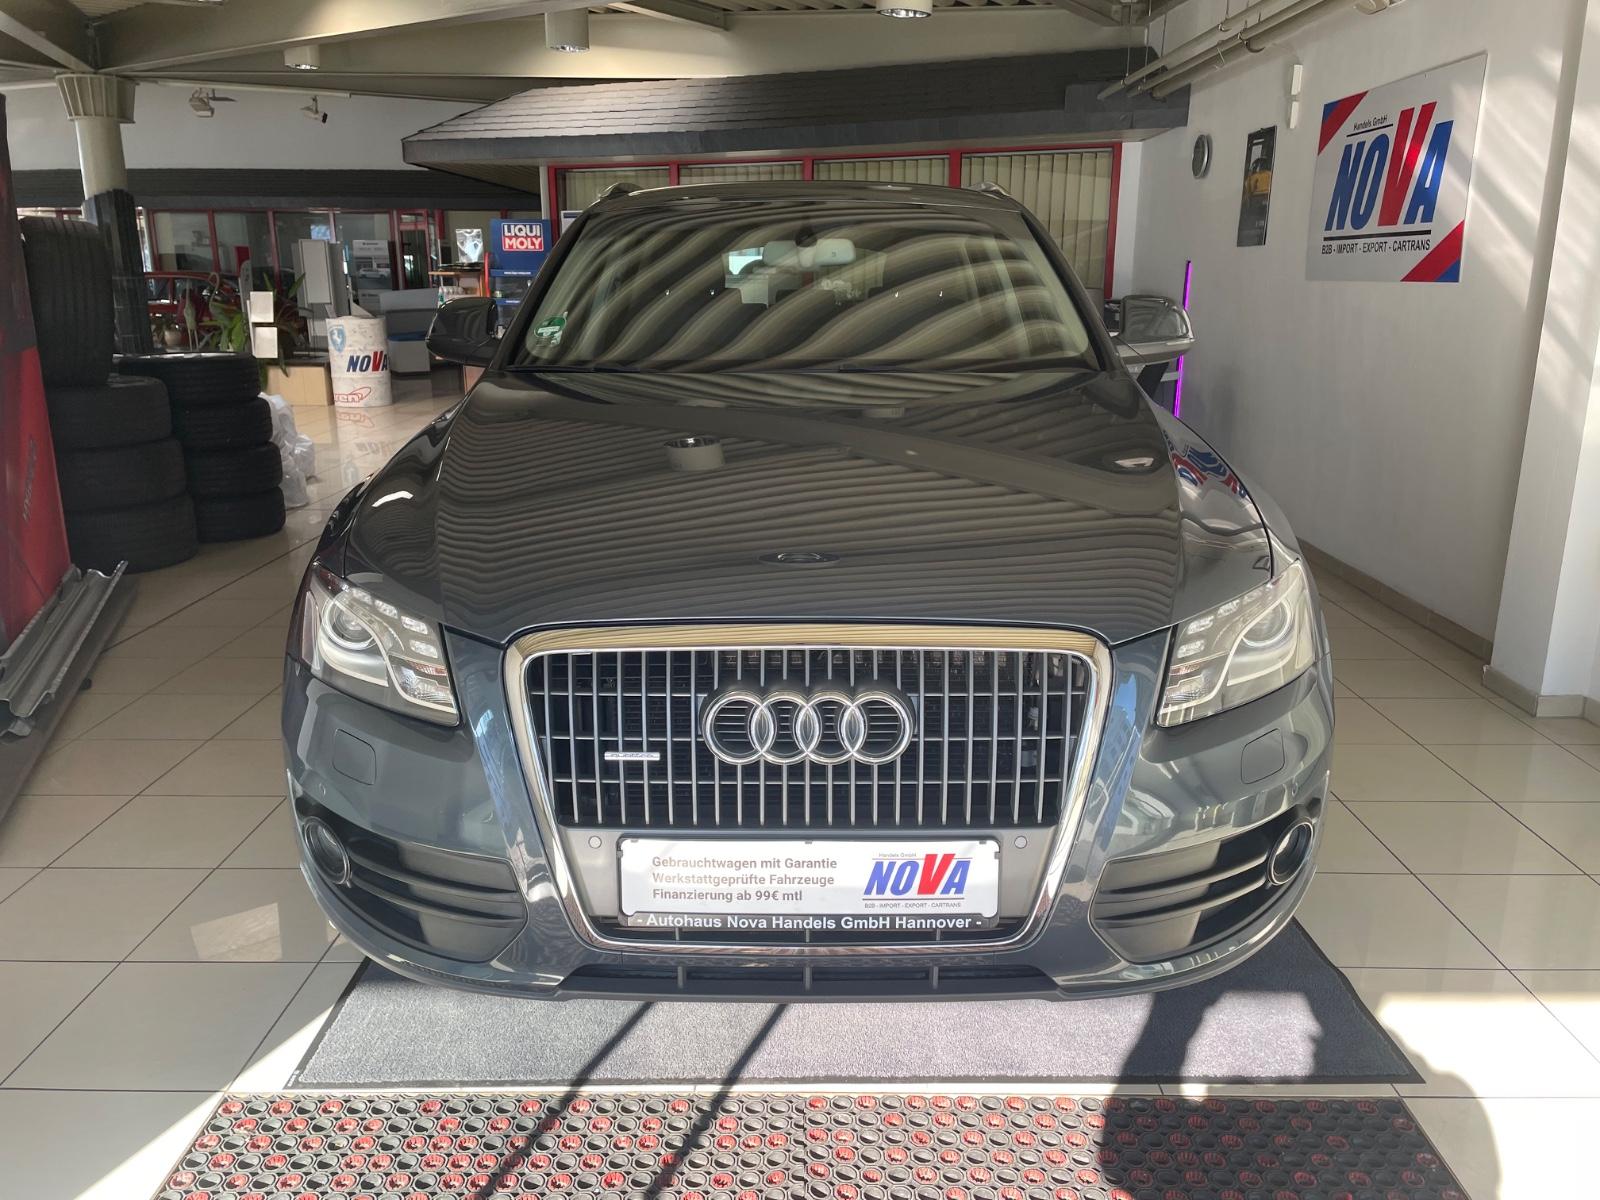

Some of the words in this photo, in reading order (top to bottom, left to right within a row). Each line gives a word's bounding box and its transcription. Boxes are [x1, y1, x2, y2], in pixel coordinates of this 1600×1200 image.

[1353, 120, 1372, 131] Handels
[1372, 114, 1388, 127] GmbH
[1324, 101, 1454, 231] NOVA
[503, 224, 540, 237] LIQUI
[505, 237, 542, 250] MOLY
[1321, 243, 1333, 255] B2B
[1336, 242, 1359, 255] IMPORT
[1362, 241, 1387, 253] EXPORT
[1392, 239, 1431, 251] CARTRANS
[346, 350, 388, 373] NOVA
[652, 856, 757, 871] Gebrauchtwagen
[760, 857, 781, 869] mit
[784, 858, 837, 869] Garantie
[652, 872, 766, 887] Werkstattgeprüfte
[769, 874, 834, 887] Fahrzeuge
[863, 853, 971, 896] NOVA
[652, 888, 732, 903] Finanzierung
[736, 889, 751, 901] ab
[755, 890, 779, 901] 99€
[782, 890, 803, 901] mtl
[646, 914, 722, 928] Autohaus
[727, 916, 767, 929] Nova
[772, 916, 836, 929] Handels
[841, 917, 890, 930] GmbH
[895, 917, 971, 929] Hannover
